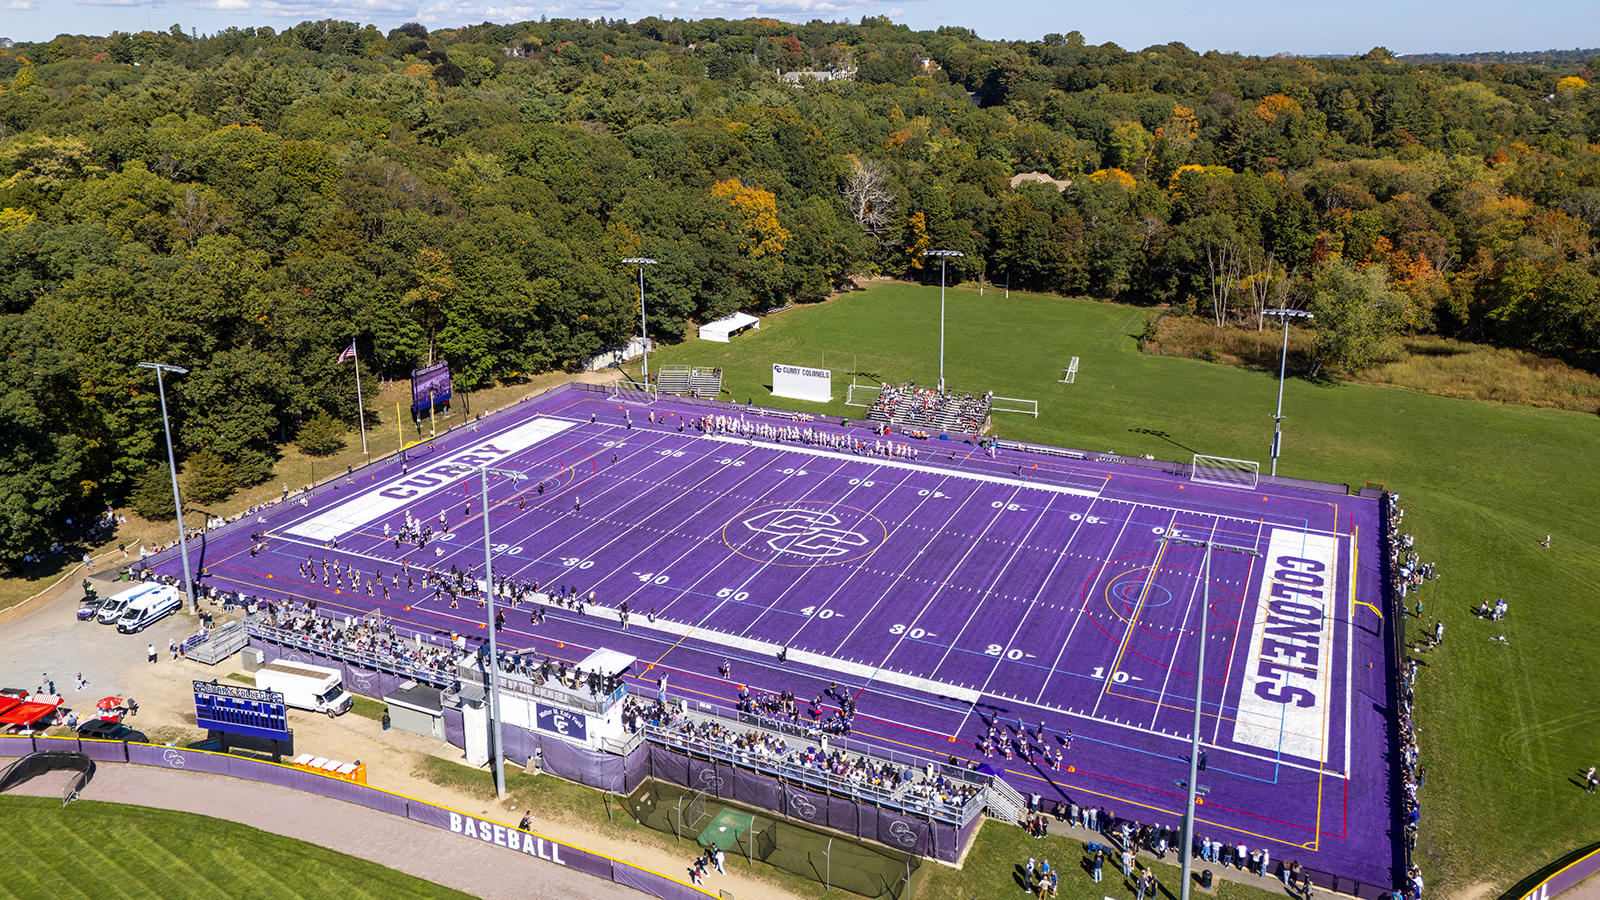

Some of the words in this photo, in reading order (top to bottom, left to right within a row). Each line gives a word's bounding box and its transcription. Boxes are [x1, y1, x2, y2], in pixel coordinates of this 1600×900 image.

[783, 366, 800, 375] CURRY
[802, 369, 829, 378] COLONELS
[379, 444, 511, 500] CURRY
[637, 572, 670, 585] 40
[716, 588, 750, 602] 50
[800, 605, 834, 620] 40
[889, 624, 928, 639] 30
[1254, 555, 1325, 708] COLONELS
[984, 644, 1025, 662] 20
[1090, 667, 1130, 684] 10
[205, 685, 234, 696] CURRY
[235, 690, 271, 701] COLLEGE
[571, 716, 584, 729] Field
[449, 811, 565, 865] BASEBALL
